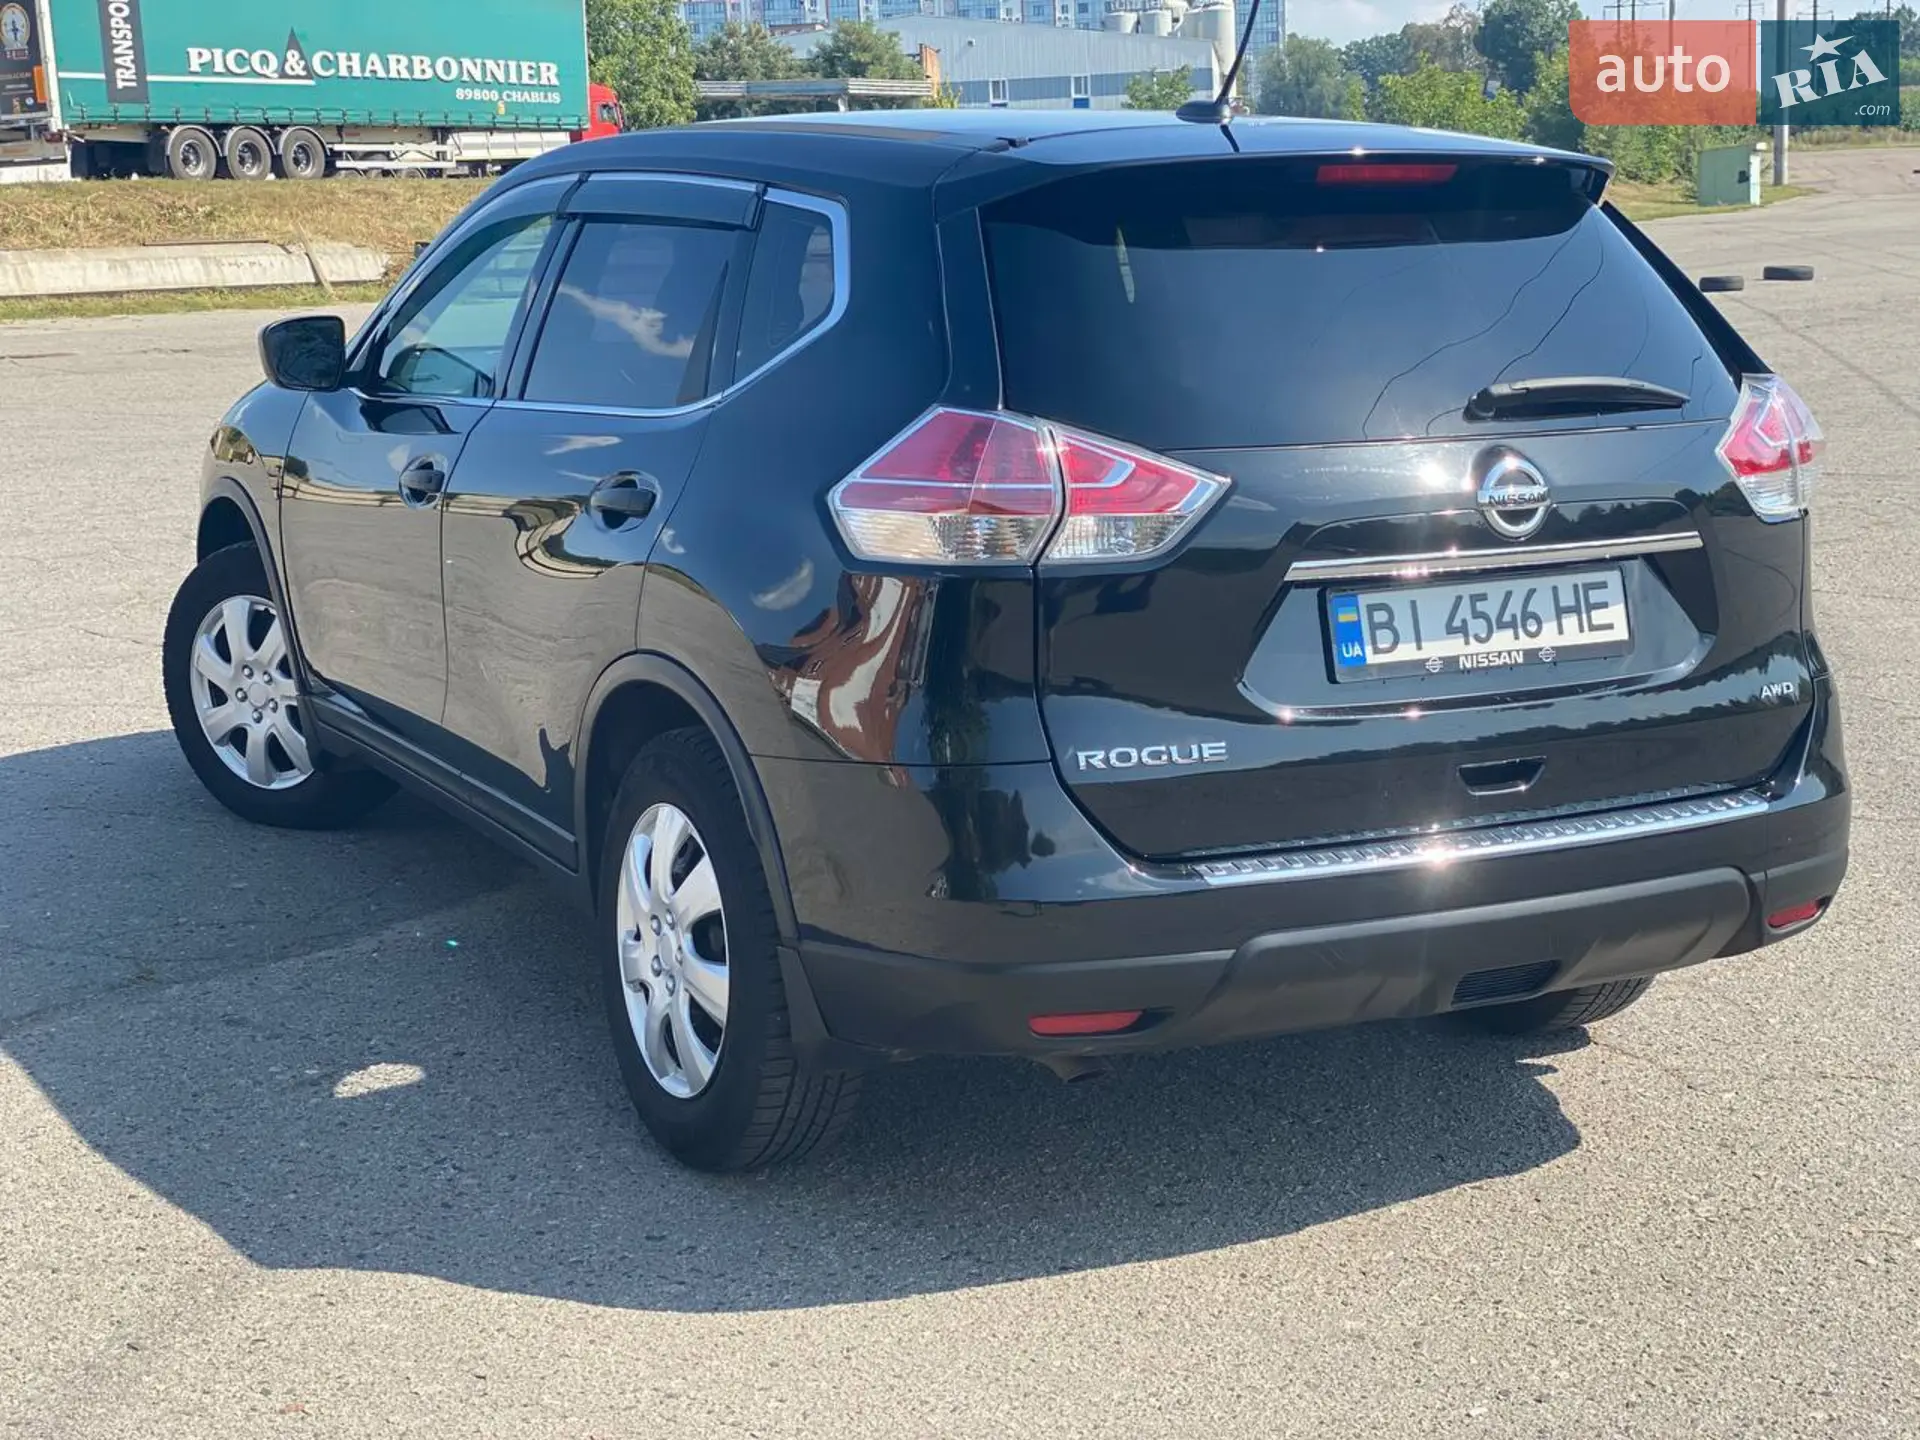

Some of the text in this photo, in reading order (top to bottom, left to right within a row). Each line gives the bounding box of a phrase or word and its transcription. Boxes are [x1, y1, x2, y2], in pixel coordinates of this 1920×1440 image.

[108, 0, 138, 89] TRANSPO
[187, 47, 279, 79] PICQ
[311, 50, 560, 87] CHARBONNIER
[456, 87, 561, 104] 89800 CHABLIS
[1488, 490, 1548, 506] NISSAN
[1366, 580, 1615, 656] BI 4546 HE
[1342, 645, 1364, 659] UA
[1458, 650, 1524, 670] NISSAN
[1761, 681, 1794, 699] AWD
[1077, 740, 1228, 771] ROGUE
